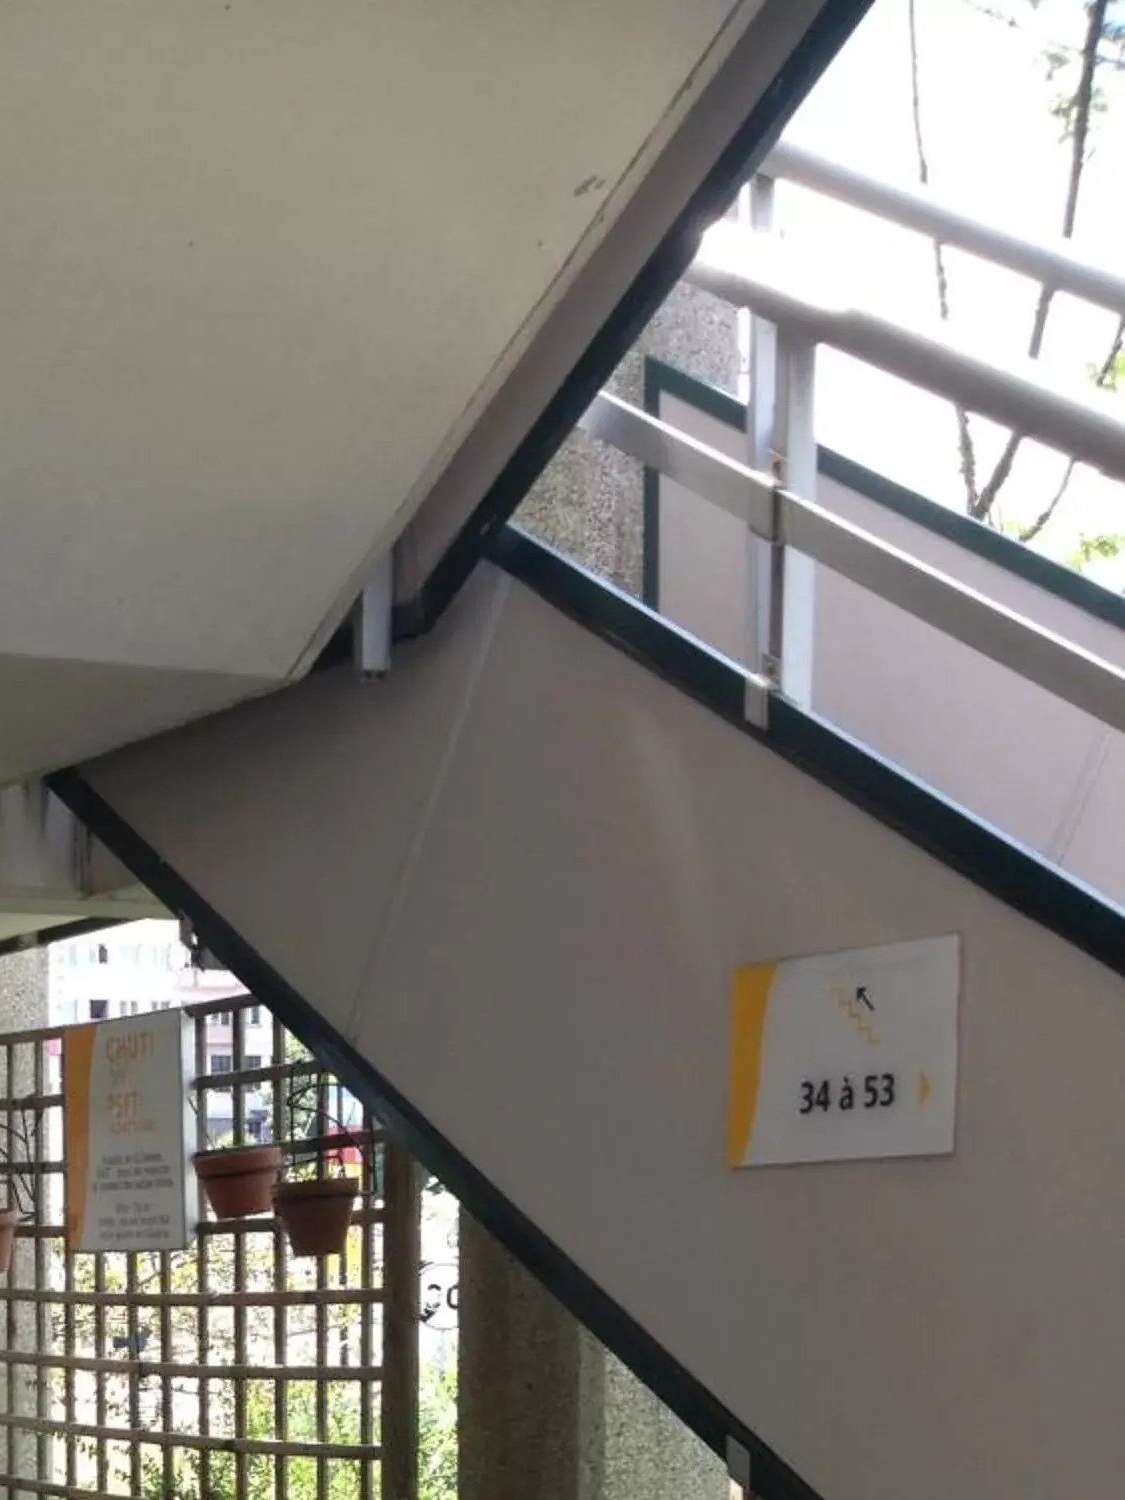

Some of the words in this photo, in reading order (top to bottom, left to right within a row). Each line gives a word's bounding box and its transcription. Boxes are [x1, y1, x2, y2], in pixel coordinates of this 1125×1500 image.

[800, 1081, 830, 1113] 34
[839, 1075, 854, 1110] à
[864, 1073, 895, 1108] 53
